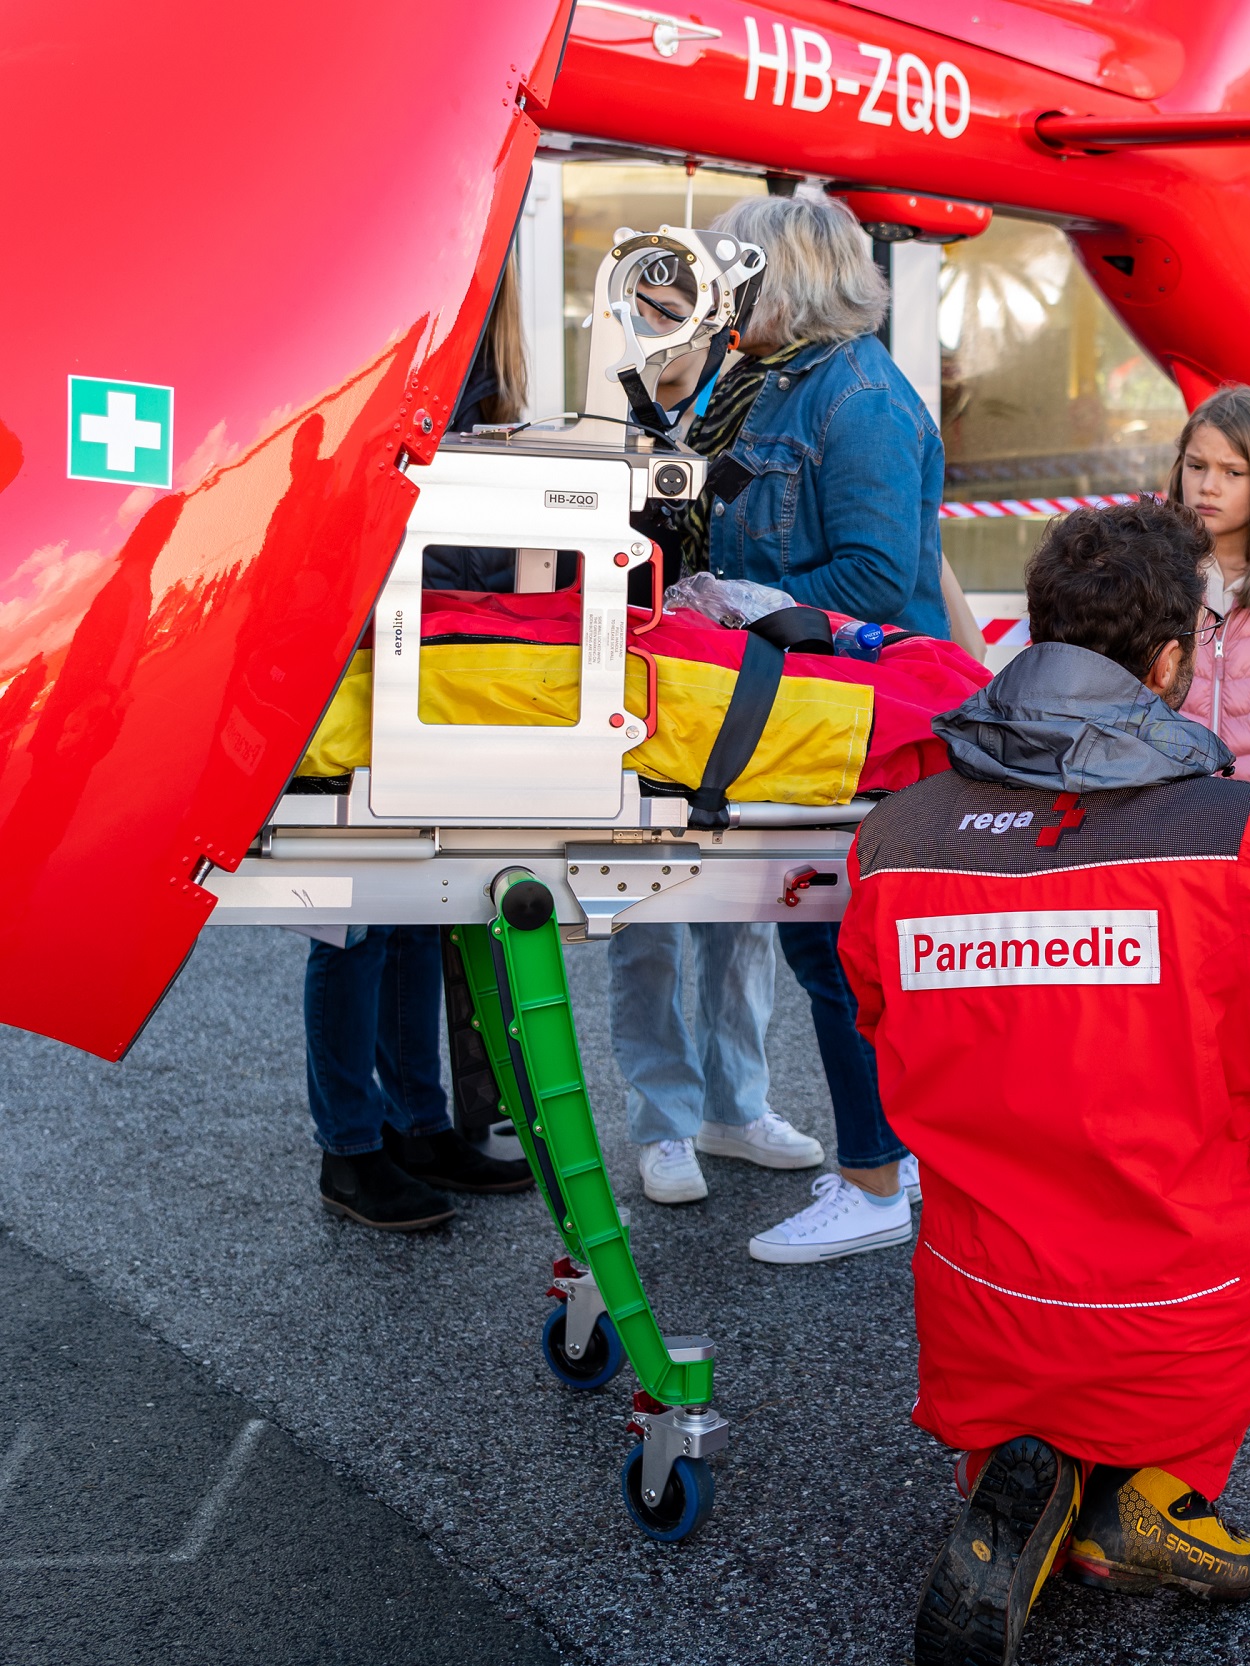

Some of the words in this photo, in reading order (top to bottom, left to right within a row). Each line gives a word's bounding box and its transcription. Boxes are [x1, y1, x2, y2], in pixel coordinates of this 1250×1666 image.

[744, 16, 970, 139] HB-ZQO
[549, 494, 594, 505] HB-ZQO
[393, 610, 403, 656] aerolite
[958, 810, 1034, 834] rega
[913, 926, 1142, 973] Paramedic
[1136, 1517, 1161, 1542] LA
[1163, 1533, 1249, 1578] SPORTIVA
